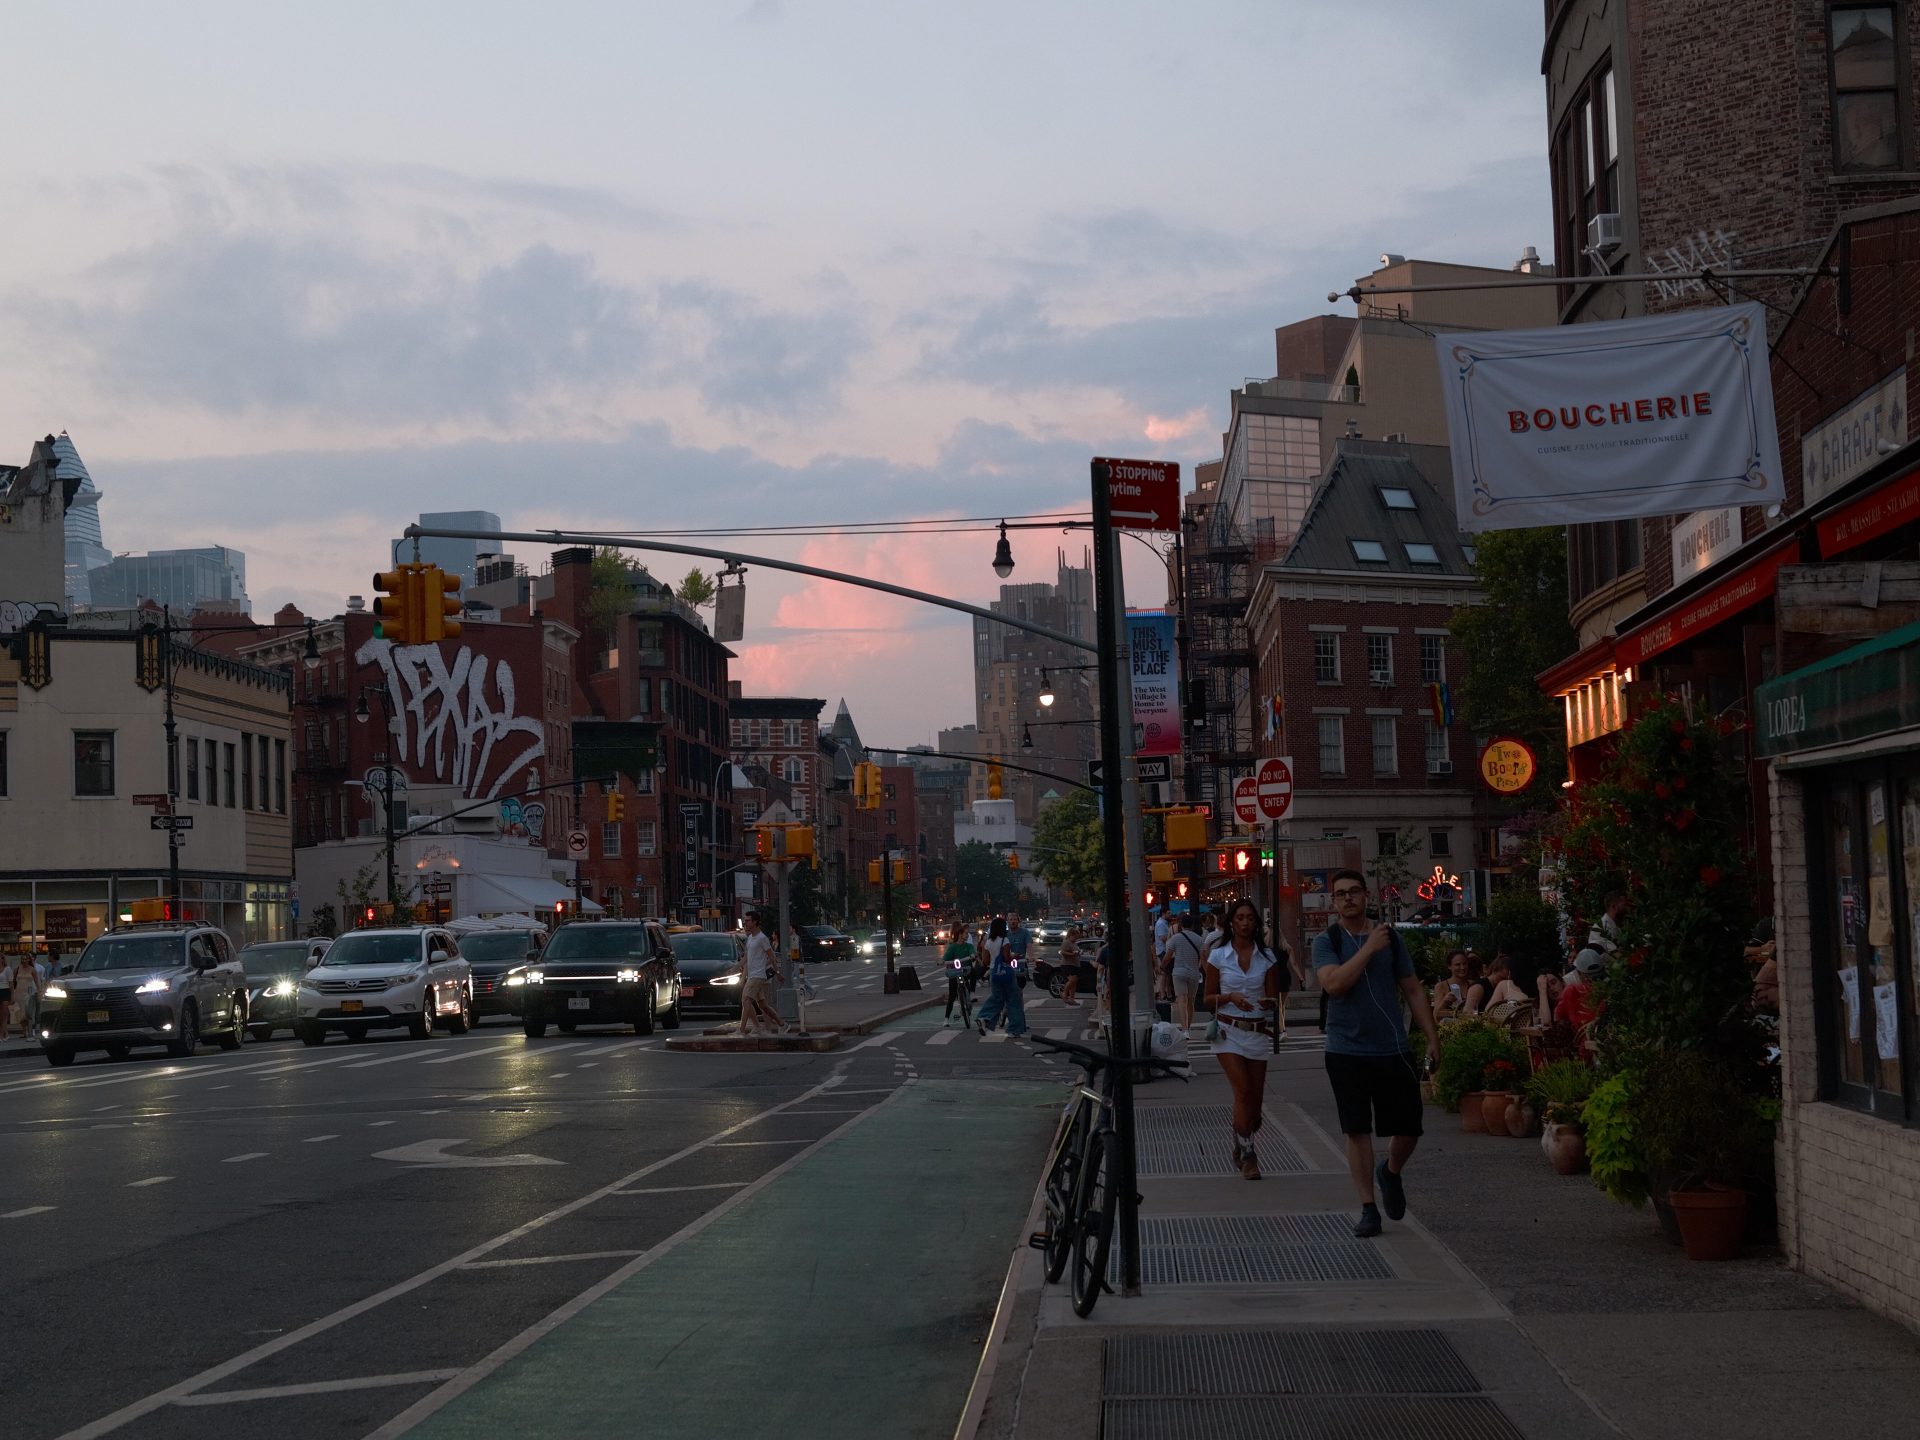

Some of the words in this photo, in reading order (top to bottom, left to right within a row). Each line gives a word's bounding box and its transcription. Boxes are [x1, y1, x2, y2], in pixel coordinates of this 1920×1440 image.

[1507, 392, 1713, 434] BOUCHERIE
[1537, 444, 1572, 454] CUISINE
[1618, 433, 1690, 446] TRADITIONNELLE
[1115, 465, 1165, 482] STOPPING
[1109, 482, 1142, 496] nytime
[1679, 511, 1730, 568] BOUCHERIE
[1132, 626, 1156, 639] THIS
[1640, 621, 1673, 656] BOUCHERIE
[1132, 638, 1163, 651] MUST
[1133, 651, 1146, 664] BE
[1151, 650, 1169, 663] THE
[1133, 663, 1167, 676] PLACE
[1134, 693, 1159, 702] Village
[1767, 695, 1806, 738] LOREA
[1138, 763, 1161, 775] WAY
[1262, 771, 1272, 782] DO
[1273, 769, 1286, 781] NOT
[1239, 787, 1248, 796] DO
[1248, 786, 1256, 795] NO
[1264, 796, 1285, 808] ENTER
[1241, 806, 1256, 815] ENTE
